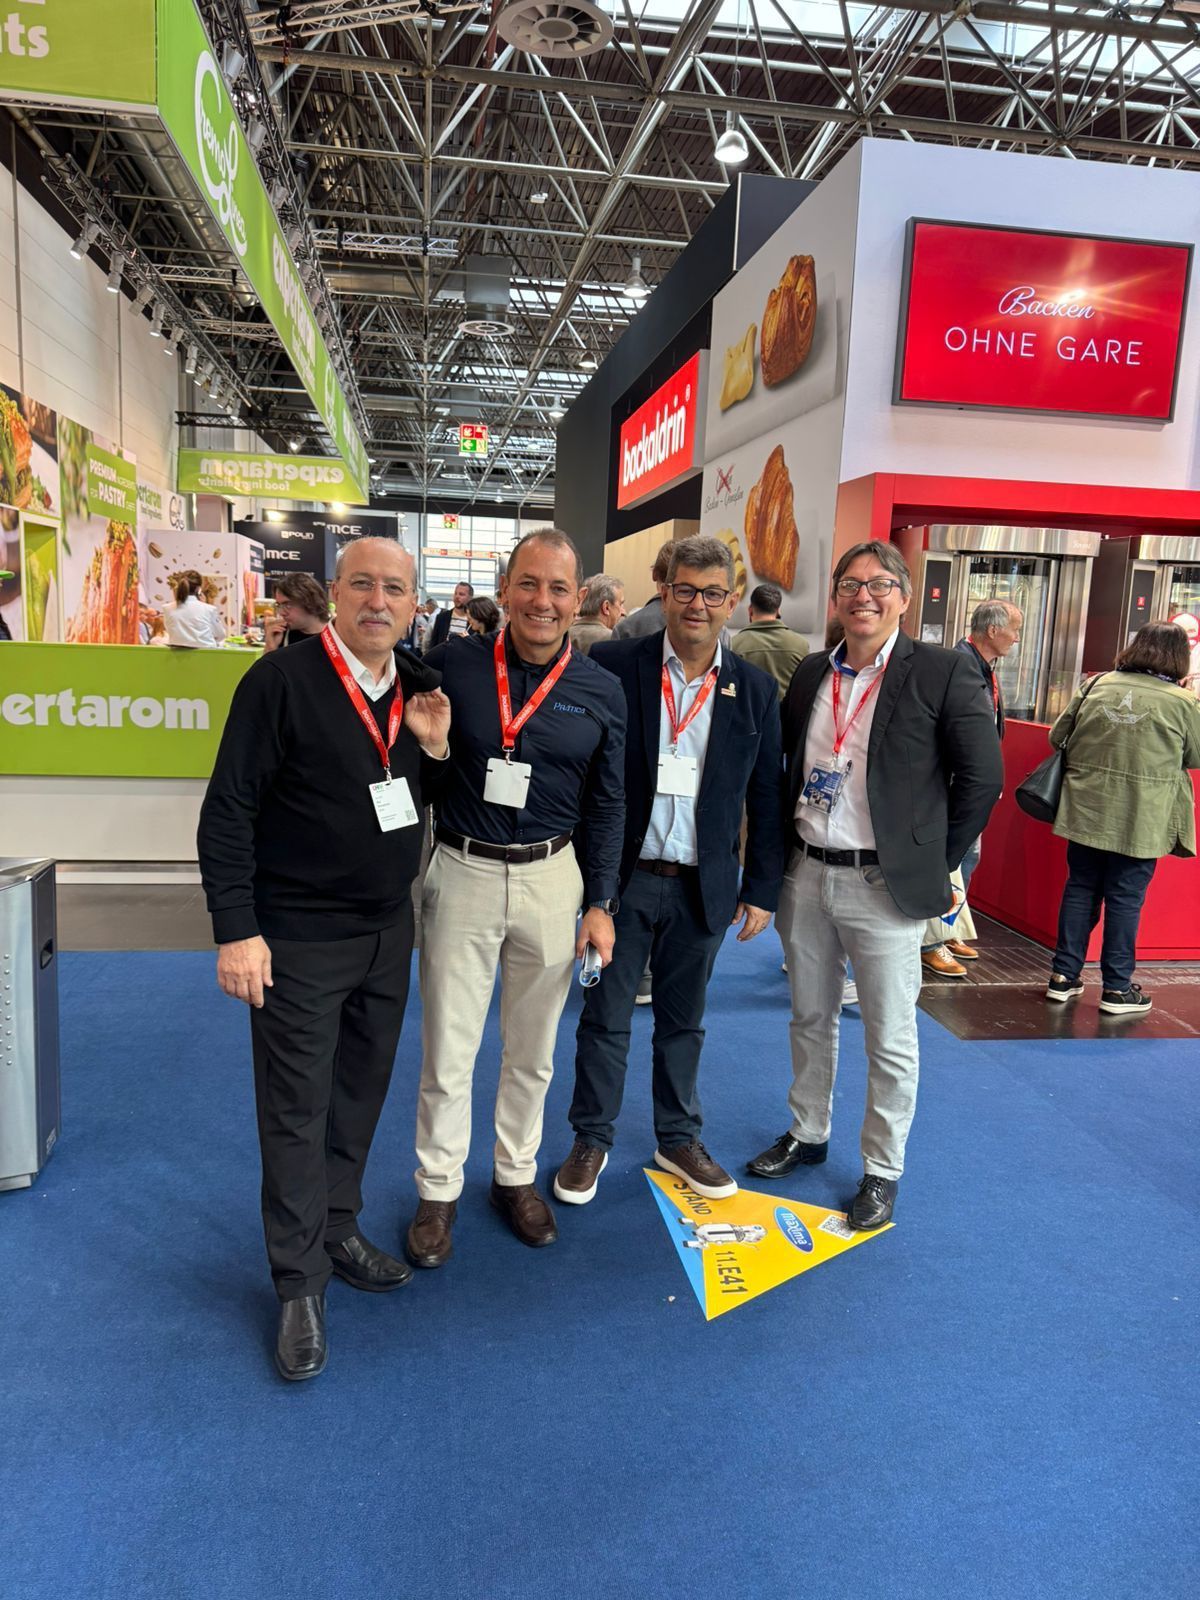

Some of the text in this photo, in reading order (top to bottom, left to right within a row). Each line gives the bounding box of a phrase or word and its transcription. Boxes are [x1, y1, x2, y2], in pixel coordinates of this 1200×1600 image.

[0, 12, 50, 58] ts
[998, 286, 1095, 319] Backen
[945, 326, 1143, 366] OHNE GARE
[98, 481, 127, 509] PASTRY
[0, 688, 210, 730] ertarom
[674, 1182, 711, 1215] STAND
[715, 1251, 748, 1294] 11.E41
